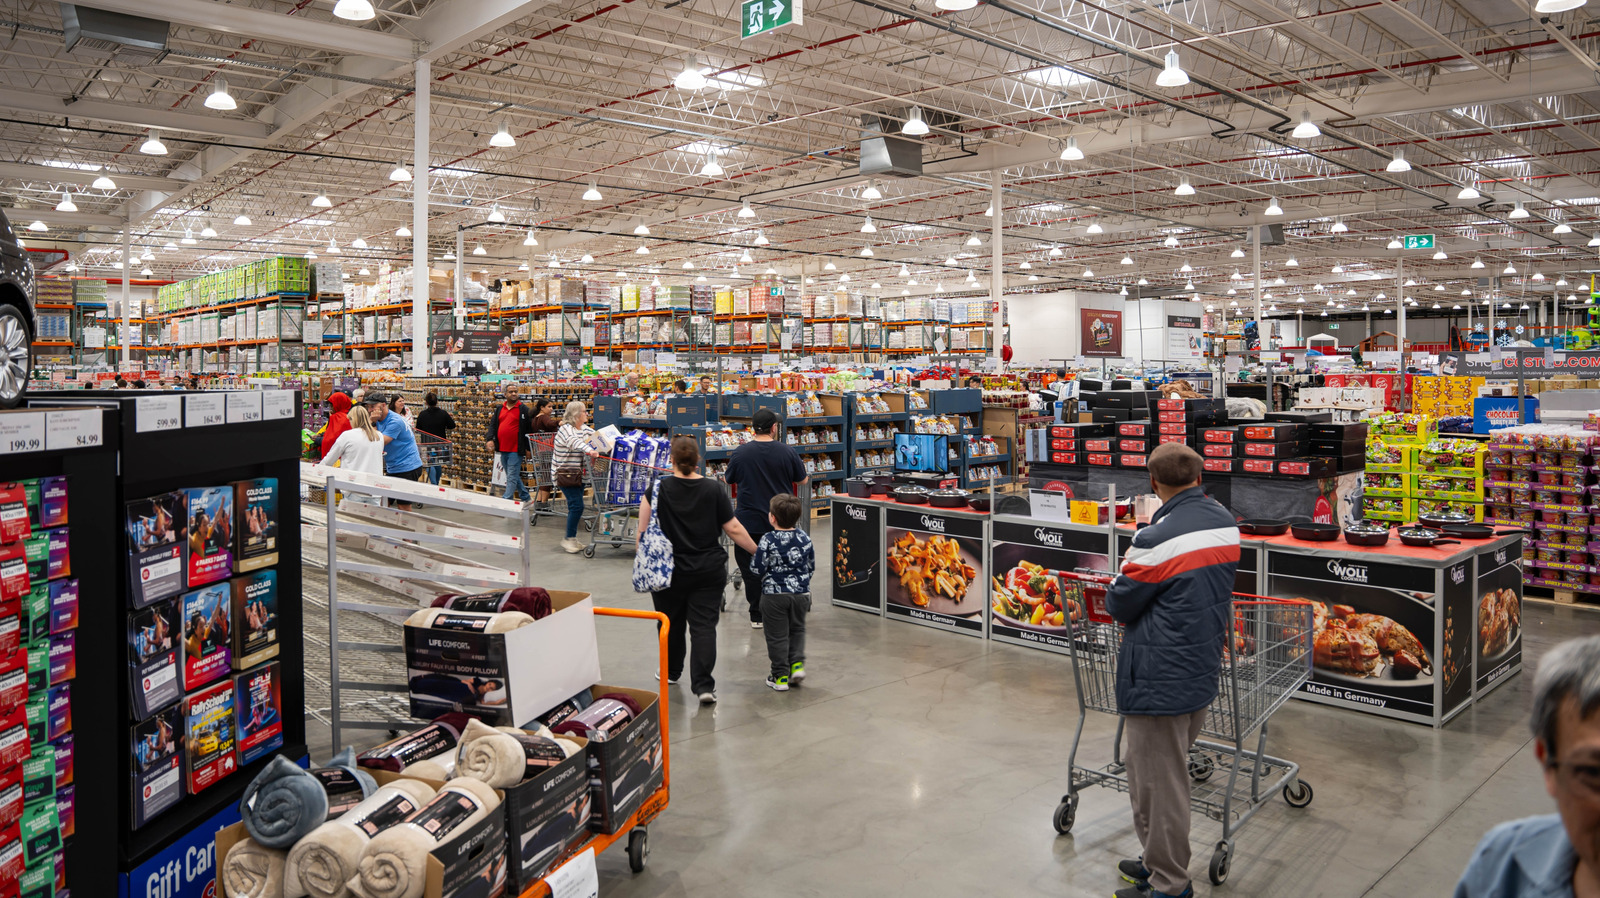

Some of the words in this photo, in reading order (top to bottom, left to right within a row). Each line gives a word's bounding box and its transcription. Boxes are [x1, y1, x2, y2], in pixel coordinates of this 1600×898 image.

[203, 414, 222, 425] 164.99
[242, 412, 259, 421] 134.99
[1486, 411, 1519, 419] CHOCOLATE
[157, 418, 178, 429] 599.99
[10, 440, 40, 451] 199.99
[76, 434, 98, 446] 84.99
[246, 488, 259, 497] GOLD
[259, 487, 273, 495] CLASS
[850, 509, 867, 517] WOLL
[926, 519, 945, 529] WOLL
[1314, 514, 1331, 525] WOLL
[1038, 532, 1063, 544] WOLL
[199, 558, 213, 566] PARKS
[215, 554, 228, 564] DAYS
[1334, 567, 1368, 579] WOLL
[1454, 568, 1465, 582] WOLL
[245, 584, 258, 593] GOLD
[258, 580, 272, 589] CLASS
[910, 610, 925, 619] Made
[932, 614, 957, 626] Germany
[429, 639, 442, 647] LIFE
[442, 640, 469, 650] COMFORT
[1020, 632, 1039, 642] Made
[1039, 635, 1046, 643] in
[1047, 637, 1070, 647] Germa
[197, 658, 211, 669] PARKS
[214, 651, 226, 662] DAYS
[474, 667, 499, 675] PILLOW
[254, 672, 272, 684] iFLY
[1307, 684, 1332, 696] Made
[1334, 689, 1342, 698] in
[1344, 692, 1387, 708] Germany
[192, 690, 225, 716] RallySchool
[626, 733, 635, 743] LIFE
[436, 740, 447, 750] LIFE
[543, 779, 555, 792] LIFE
[555, 766, 577, 785] COMFORT
[25, 782, 45, 794] Kayo
[565, 791, 577, 803] BODY
[458, 840, 472, 855] LIFE
[472, 823, 494, 847] COMFORT
[146, 858, 182, 898] Gift
[185, 830, 219, 883] Car
[480, 855, 492, 867] BODY
